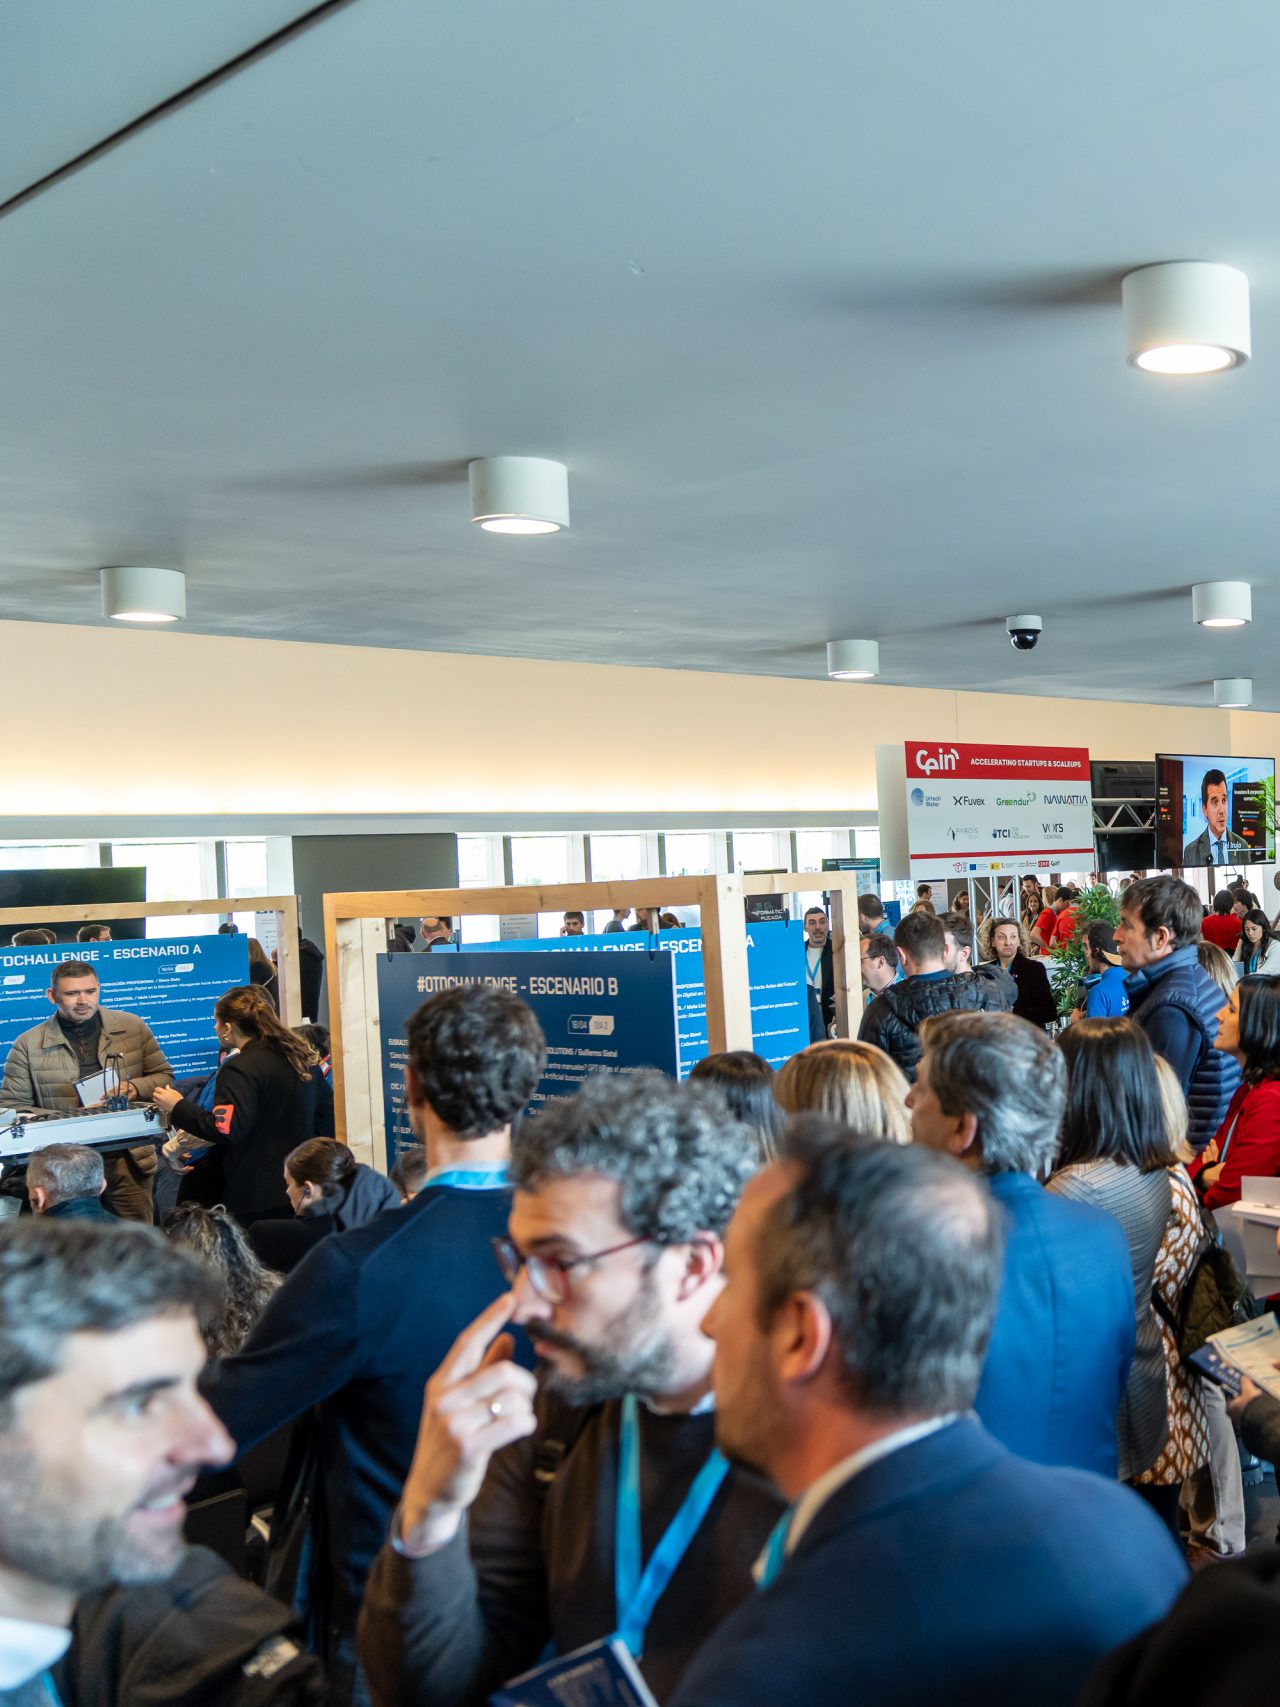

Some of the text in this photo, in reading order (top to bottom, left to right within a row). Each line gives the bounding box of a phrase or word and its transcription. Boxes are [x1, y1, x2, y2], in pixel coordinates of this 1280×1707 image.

[971, 758, 1017, 766] ACCELERATING
[1017, 759, 1047, 768] STARTUPS
[1053, 760, 1081, 768] SCALEUPS
[963, 796, 985, 806] Fuvex
[996, 796, 1030, 806] Greendur
[113, 944, 190, 960] ESCENARIO
[192, 943, 202, 954] A
[529, 976, 604, 995] ESCENARIO
[608, 977, 618, 995] B
